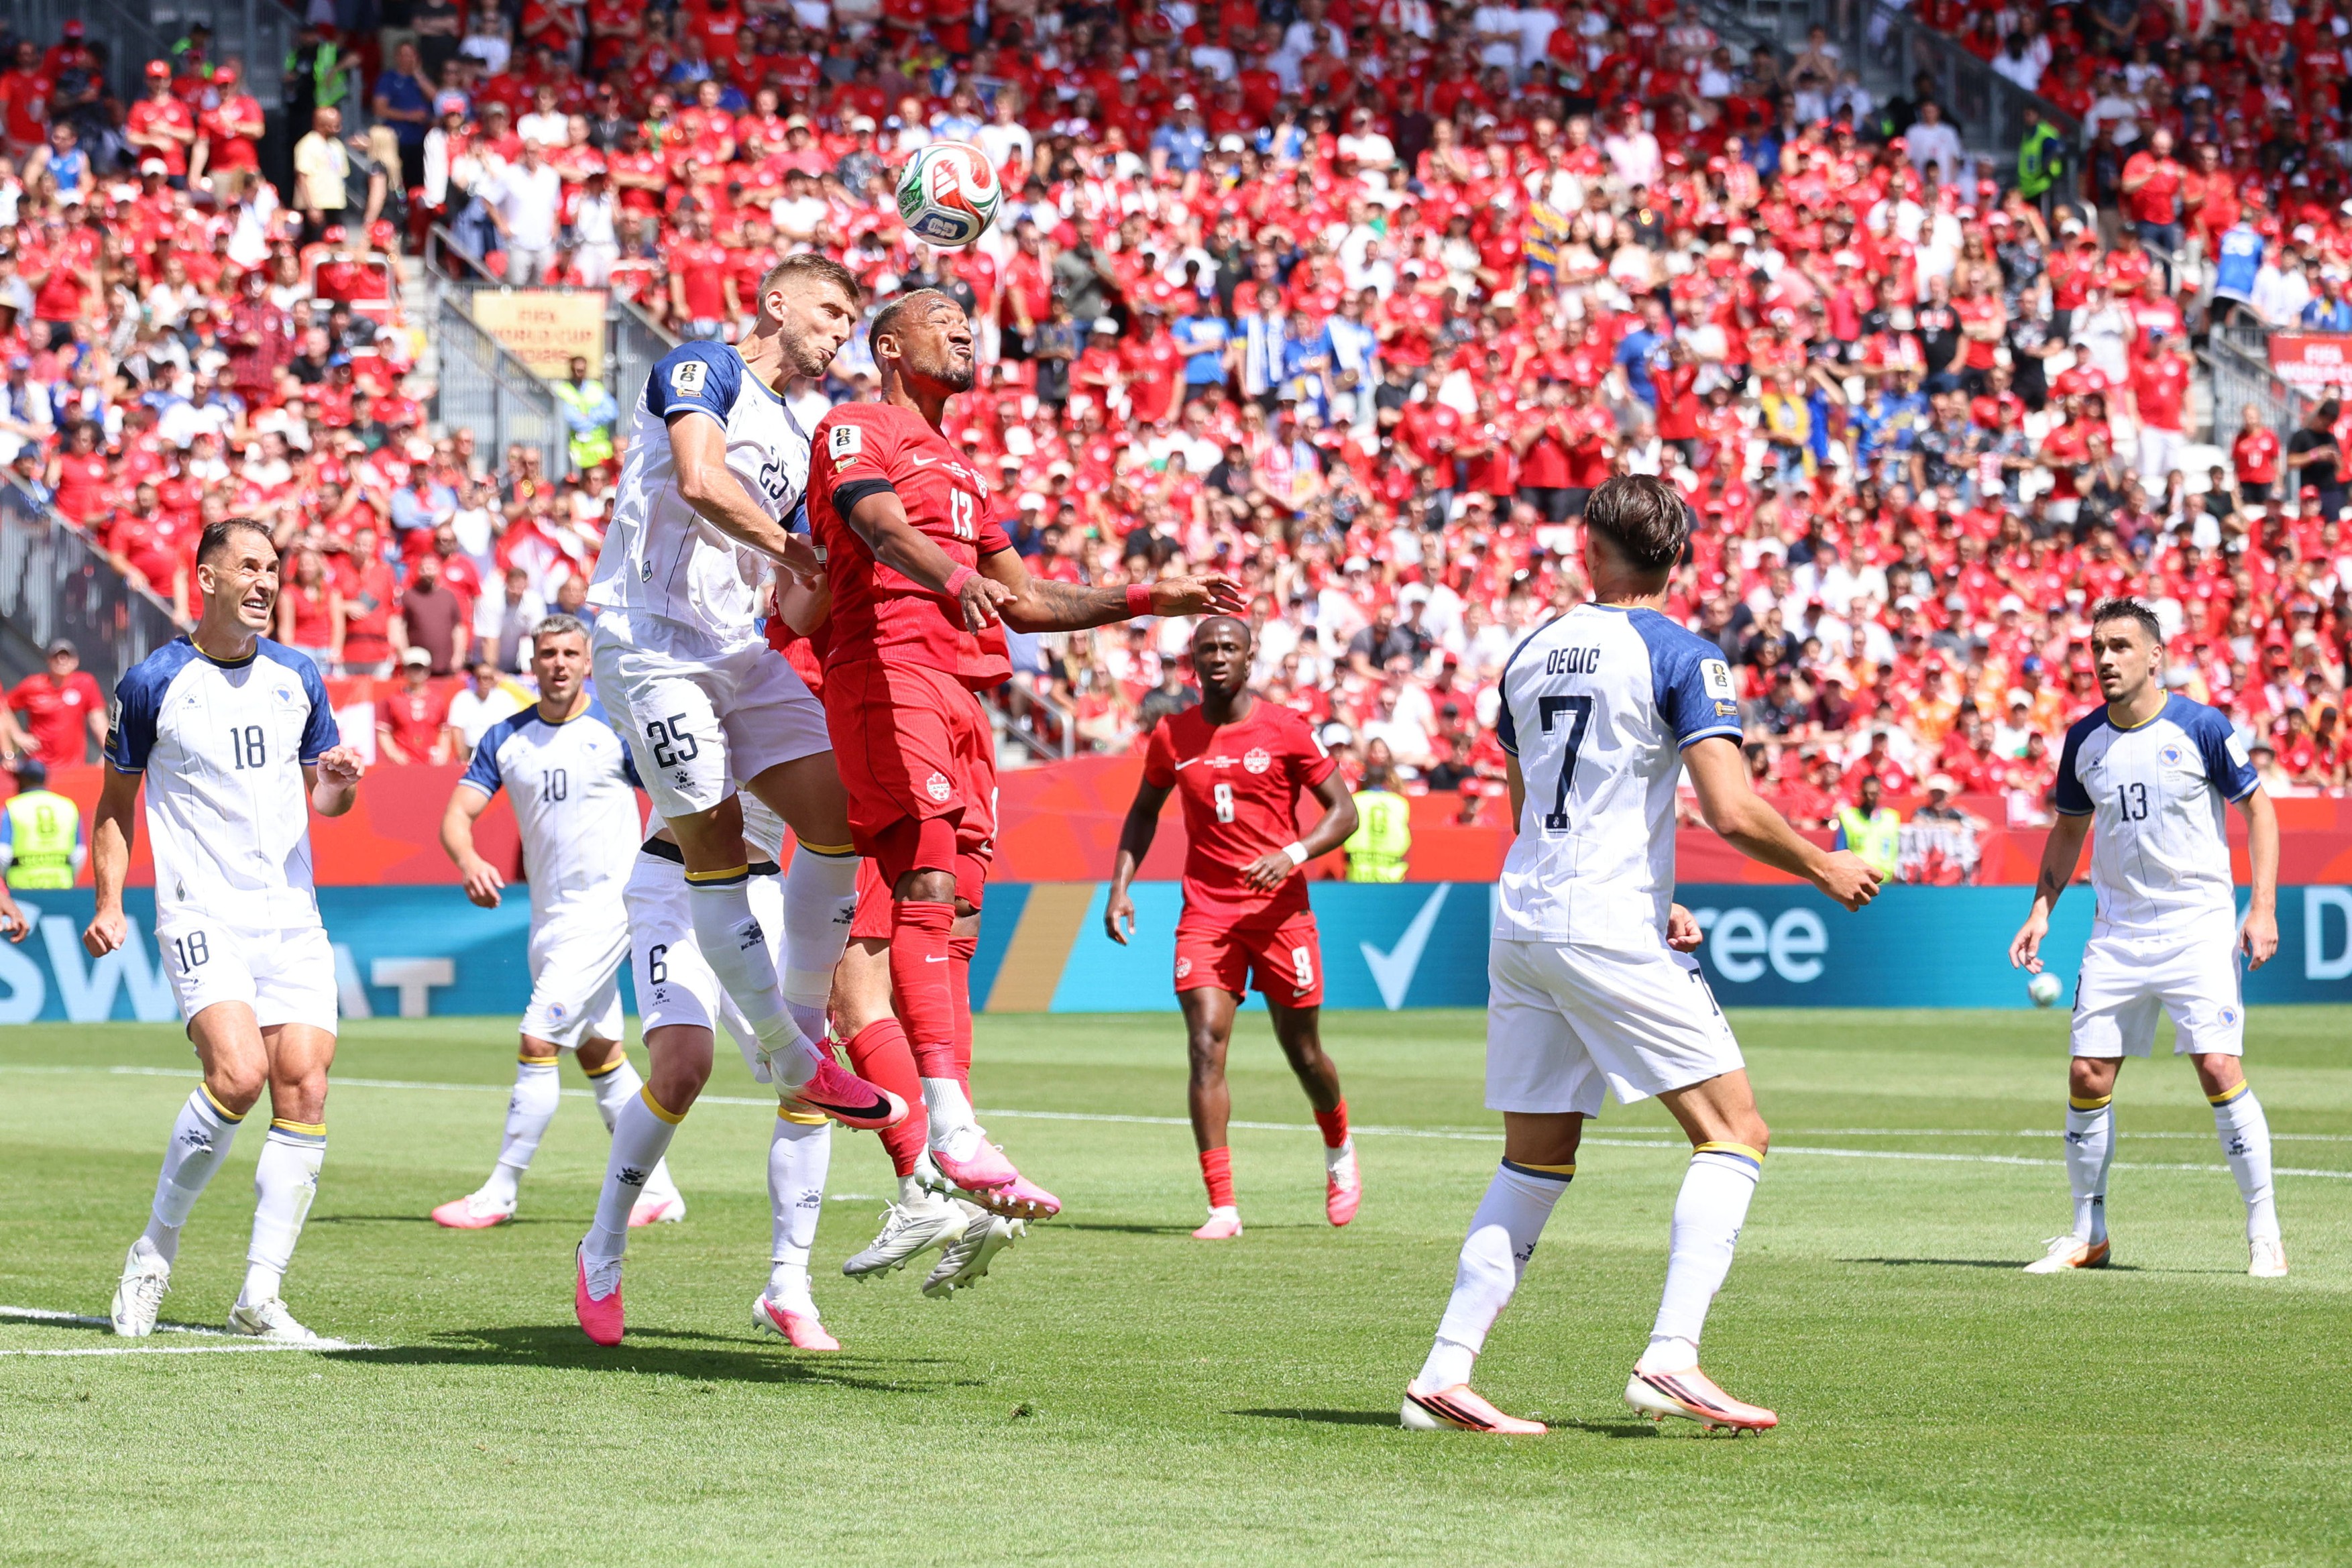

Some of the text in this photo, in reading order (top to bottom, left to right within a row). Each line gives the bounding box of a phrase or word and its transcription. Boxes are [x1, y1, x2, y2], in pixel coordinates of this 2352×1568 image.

[759, 445, 789, 500] 25
[950, 488, 973, 540] 13
[230, 725, 266, 770] 18
[647, 712, 699, 769] 25
[543, 769, 567, 802] 10
[675, 781, 696, 790] KELME
[1538, 695, 1595, 833] 7
[1214, 783, 1235, 824] 8
[2117, 782, 2147, 822] 13
[176, 930, 209, 975] 18
[649, 944, 667, 985] 6
[652, 998, 671, 1007] KELME
